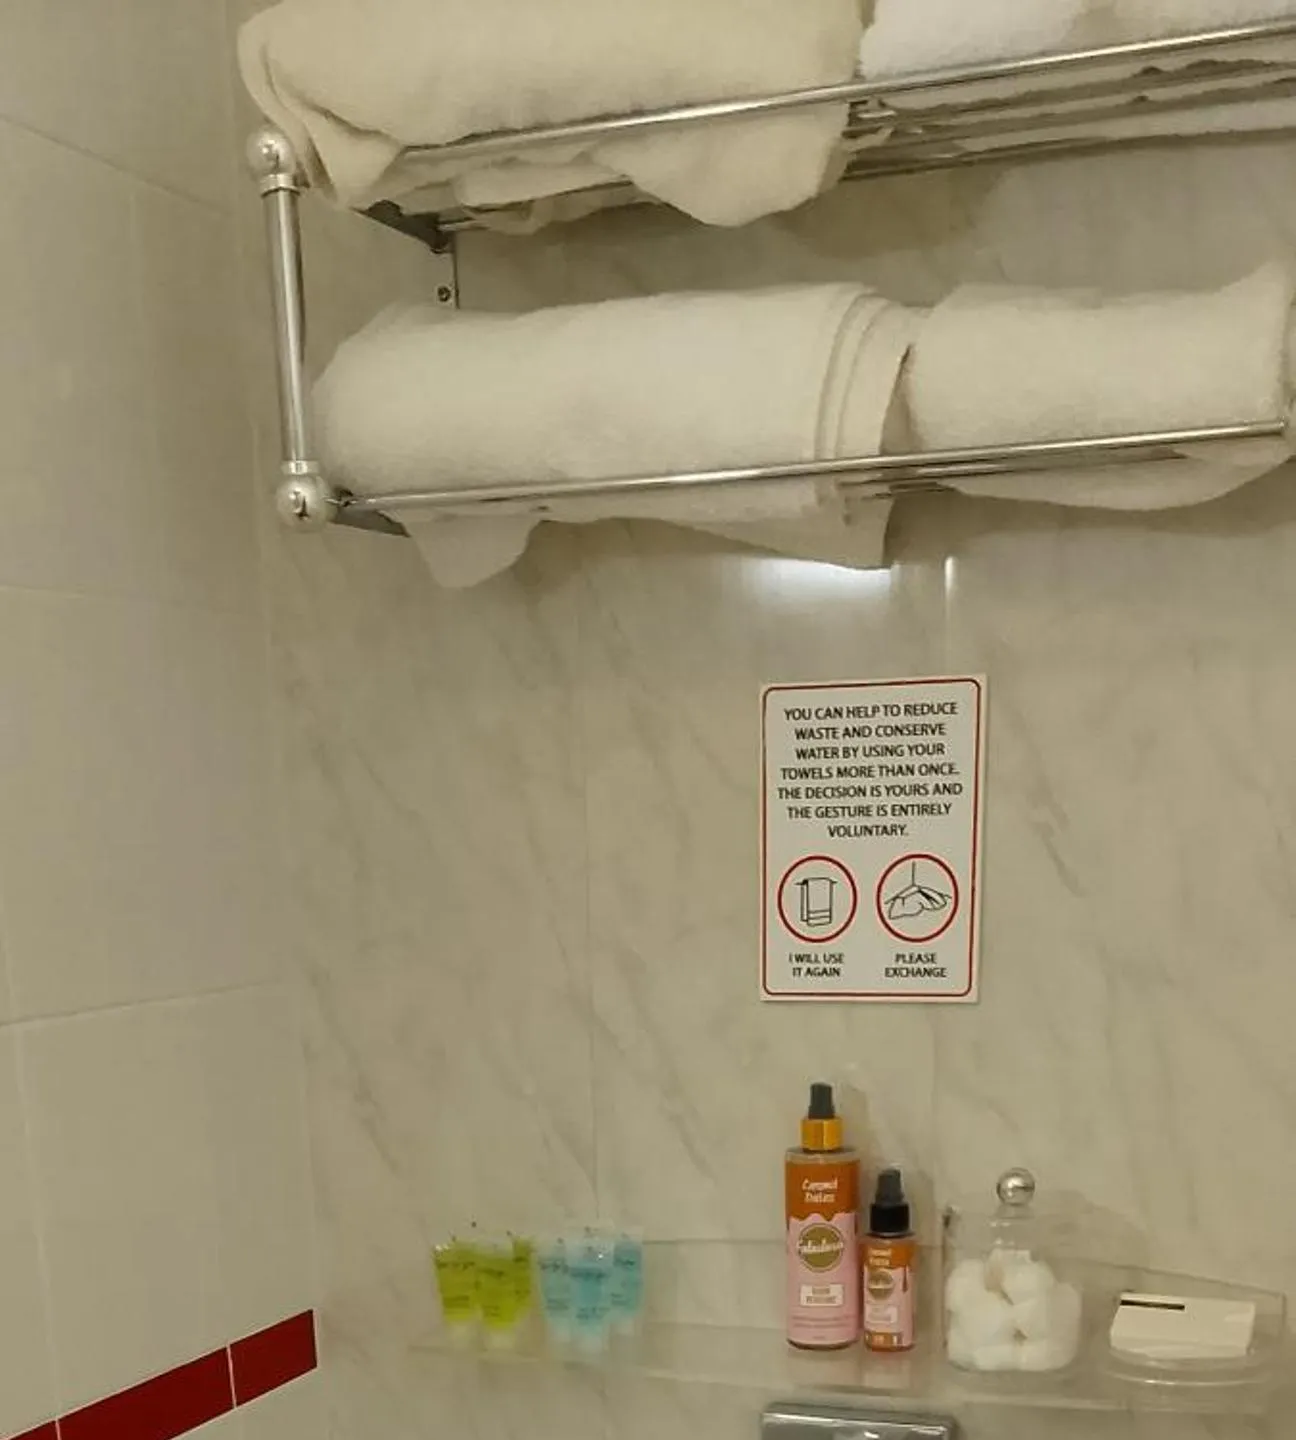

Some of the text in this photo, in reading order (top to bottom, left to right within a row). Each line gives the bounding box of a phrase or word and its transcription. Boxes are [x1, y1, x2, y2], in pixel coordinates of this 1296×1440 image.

[785, 702, 957, 720] YOU CAN HELP TO REDUCE
[795, 724, 946, 740] WASTE AND CONSERVE
[796, 743, 945, 759] WATER BY USING YOUR
[781, 763, 959, 780] TOWELS MORE THAN ONCE.
[778, 783, 962, 799] THE DECISION IS YOURS AND
[787, 803, 952, 819] THE GESTURE IS ENTIRELY
[828, 824, 908, 838] VOLUNTARY.
[789, 954, 844, 964] I WILL USE
[895, 953, 937, 964] PLEASE
[793, 968, 840, 977] IT AGAIN
[885, 968, 946, 978] EXCHANGE
